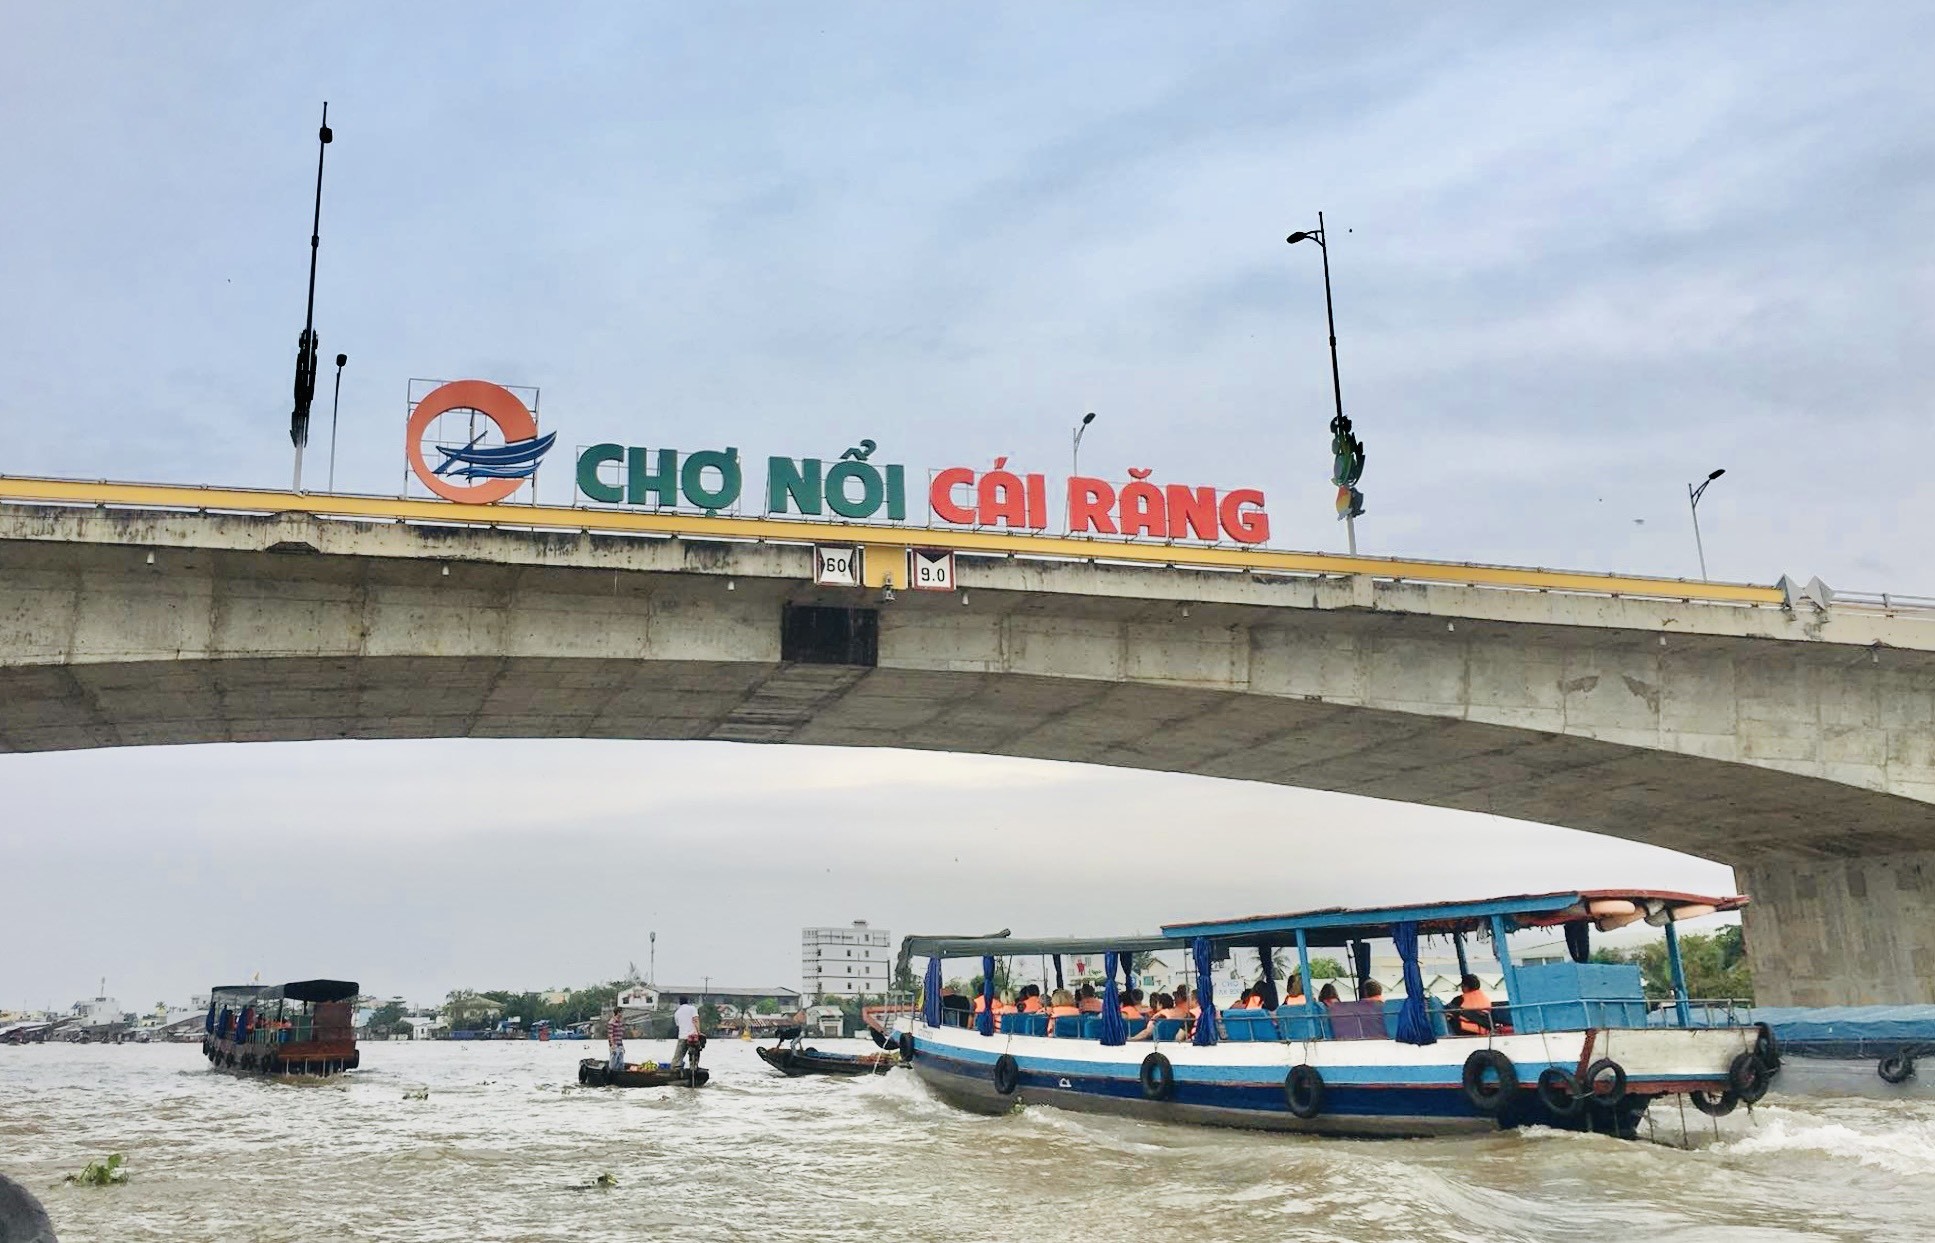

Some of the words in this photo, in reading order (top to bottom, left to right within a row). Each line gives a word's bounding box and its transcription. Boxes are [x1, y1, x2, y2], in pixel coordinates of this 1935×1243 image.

[575, 443, 741, 518] CHỢ
[768, 440, 906, 521] NỔI
[929, 457, 1048, 529] CÁI
[1068, 467, 1270, 544] RĂNG
[826, 557, 847, 573] 60
[921, 567, 945, 582] 9.0
